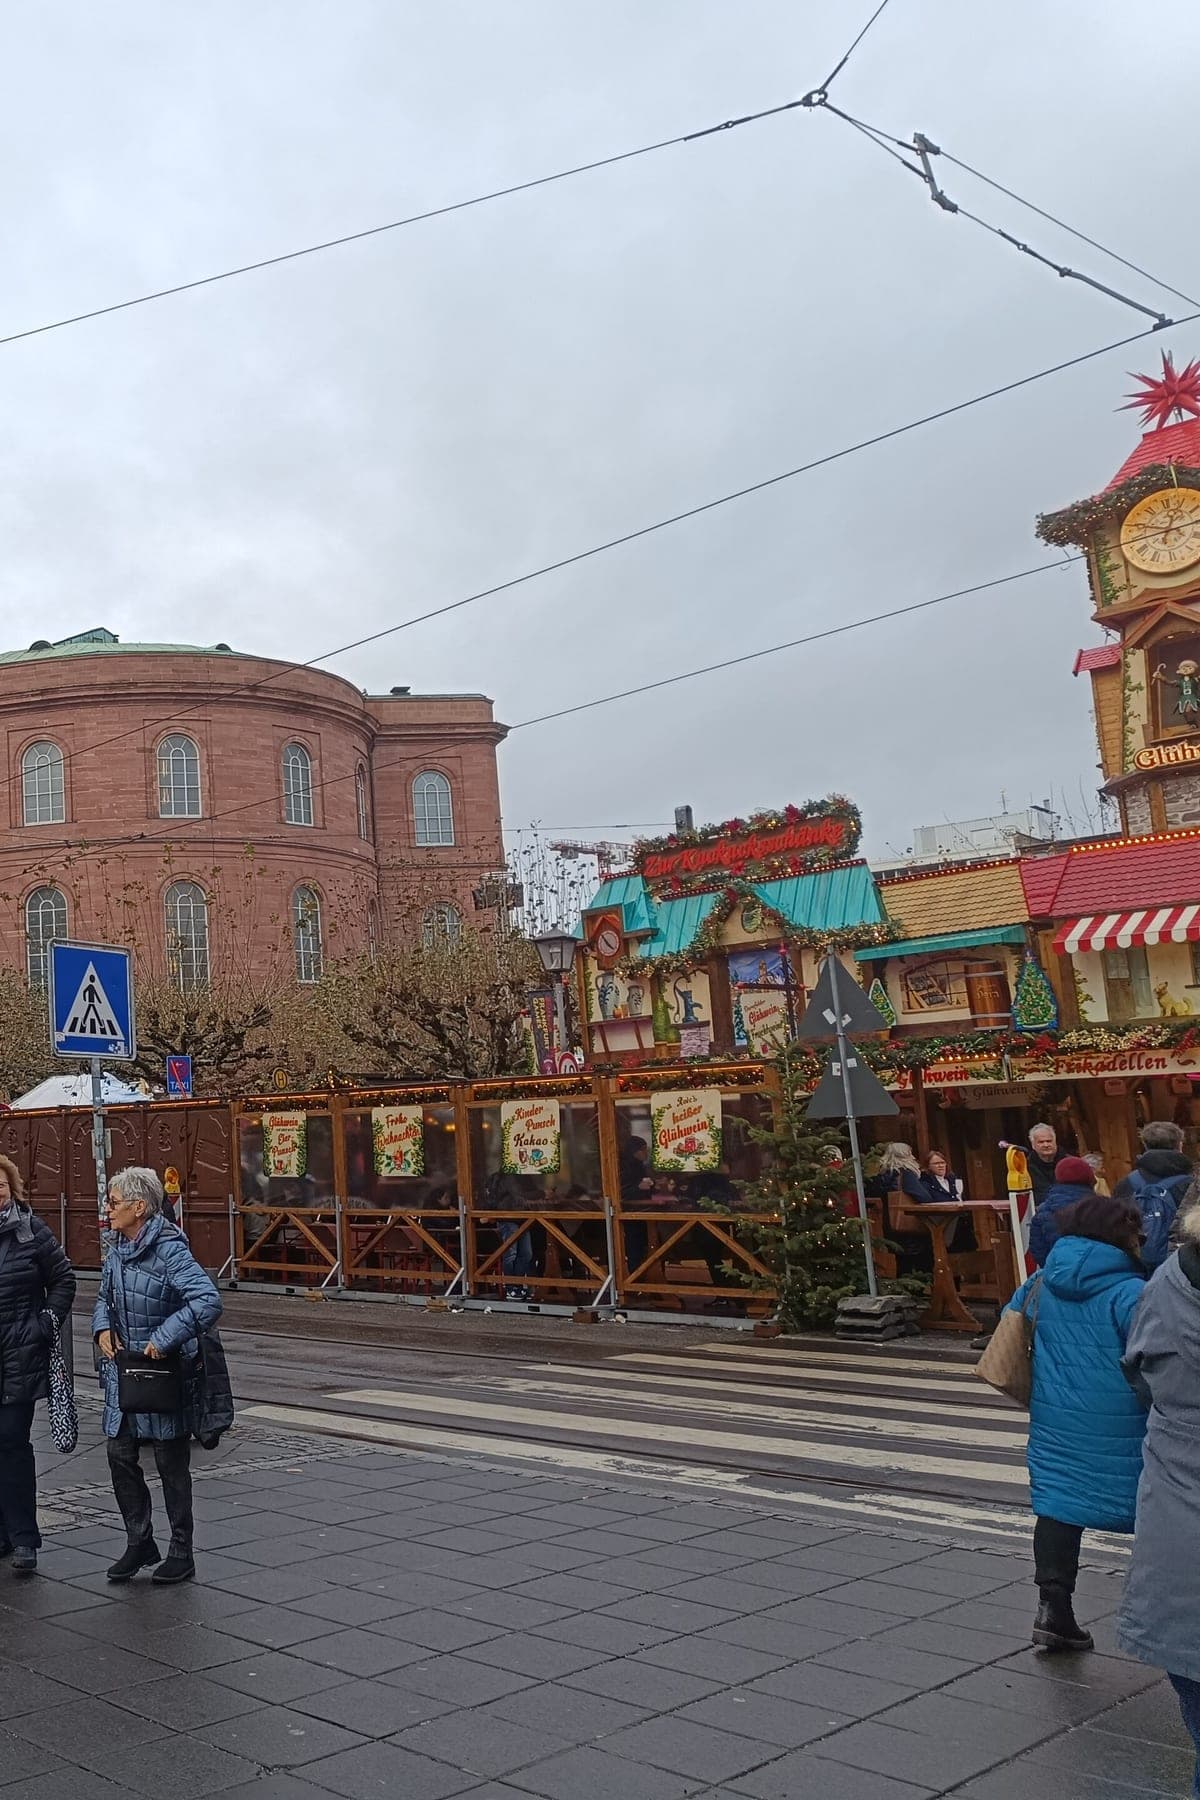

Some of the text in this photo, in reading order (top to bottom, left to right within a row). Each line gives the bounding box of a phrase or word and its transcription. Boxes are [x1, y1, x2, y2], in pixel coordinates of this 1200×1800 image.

[1136, 741, 1200, 768] Glüh
[644, 854, 676, 877] Zur
[1055, 1052, 1168, 1076] Frikadellen
[898, 1066, 969, 1088] Glhwein
[170, 1082, 189, 1090] TAXI
[973, 1085, 1028, 1101] Glühwein
[514, 1104, 544, 1121] Kinder
[671, 1104, 703, 1124] heißer
[268, 1116, 299, 1130] Glühwein
[525, 1114, 556, 1131] Punsch
[513, 1132, 549, 1147] Kakao
[659, 1119, 709, 1149] Glühwein
[271, 1142, 297, 1157] Punsch
